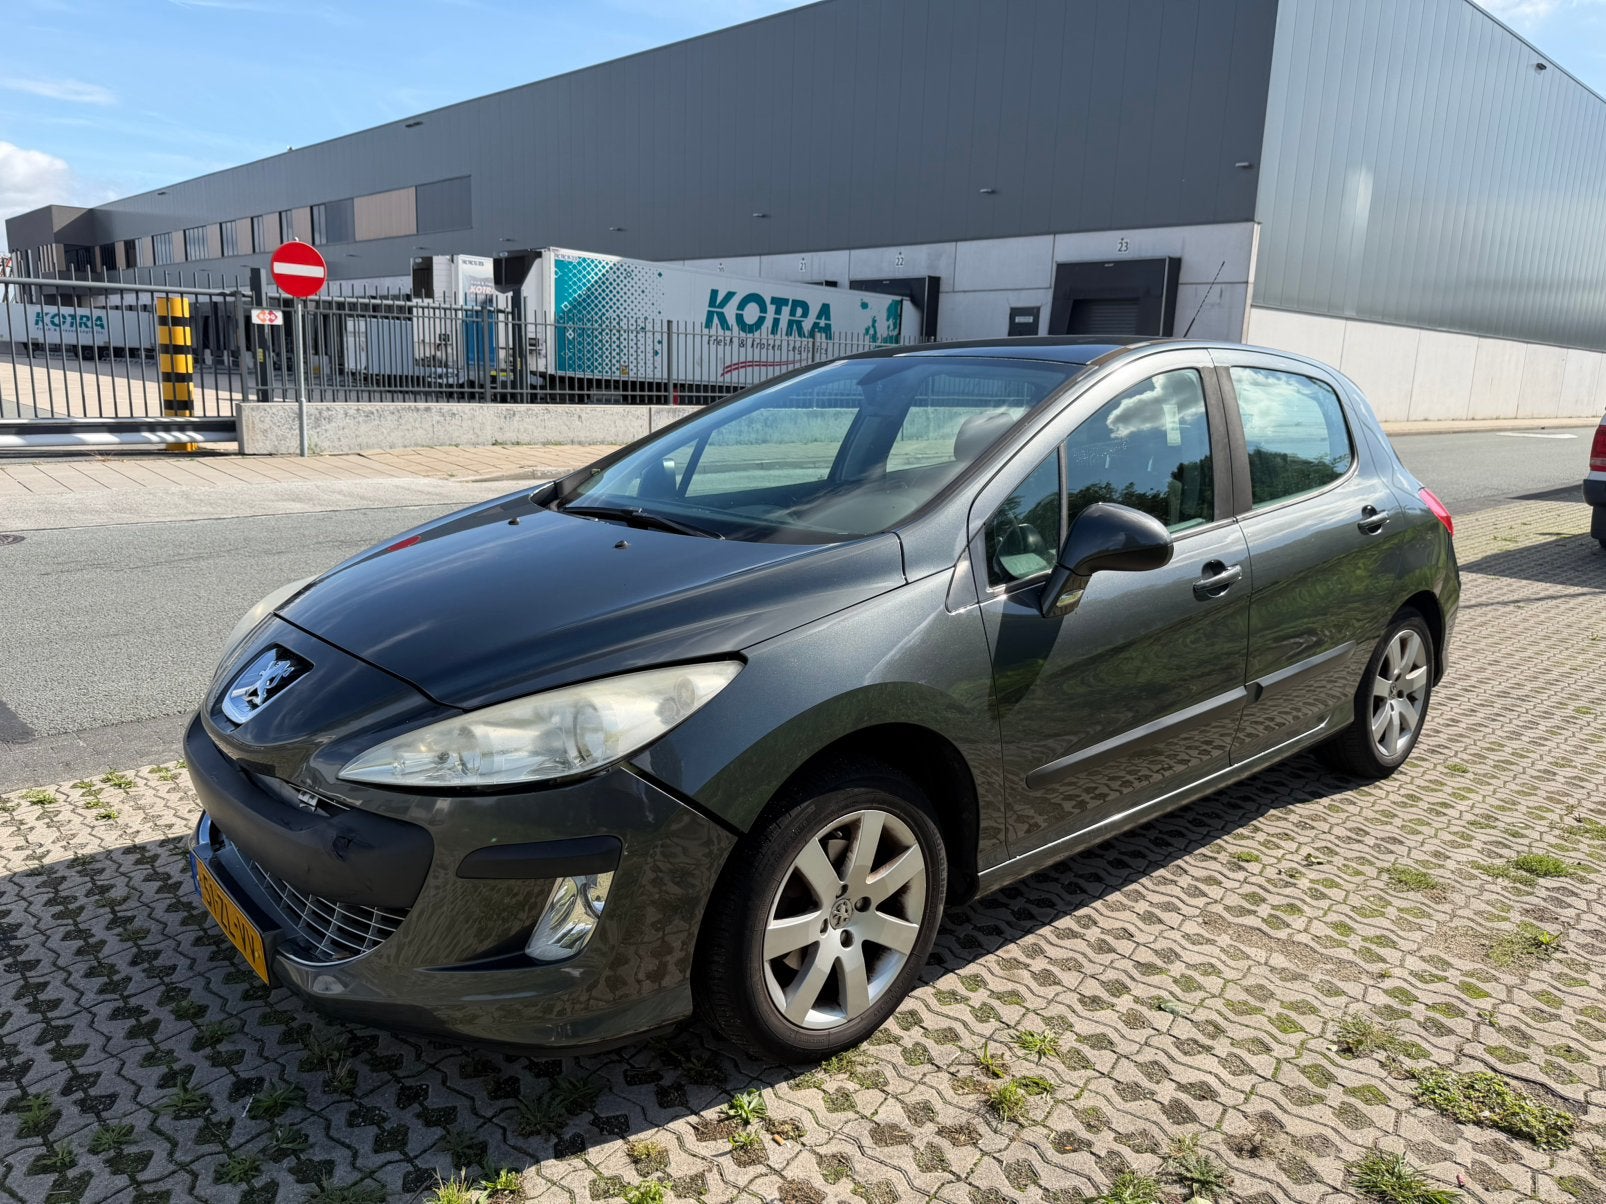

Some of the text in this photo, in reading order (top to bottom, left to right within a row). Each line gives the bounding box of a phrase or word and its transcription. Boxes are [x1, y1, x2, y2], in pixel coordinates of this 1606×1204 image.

[1118, 241, 1128, 252] 23
[895, 256, 904, 266] 22
[468, 285, 494, 295] KOTR
[704, 289, 832, 341] KOTRA
[35, 312, 105, 330] KOTRA
